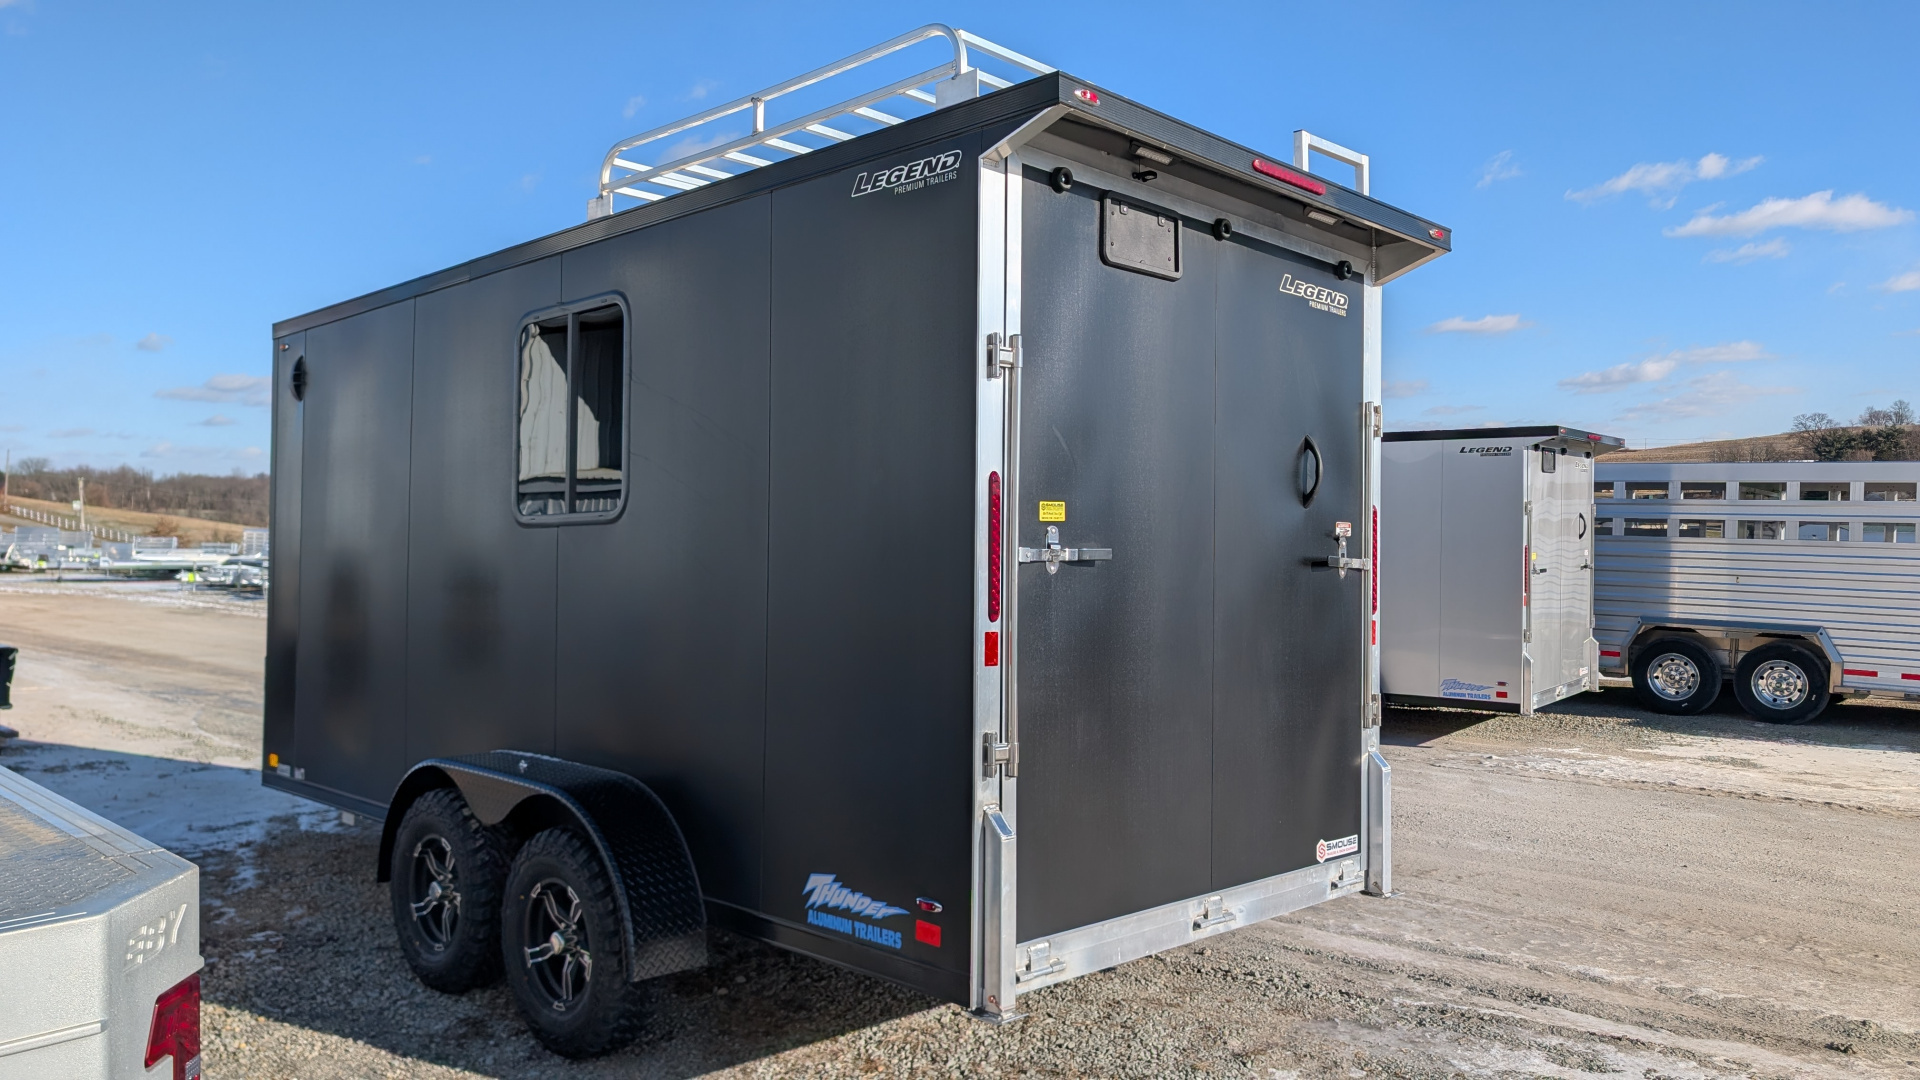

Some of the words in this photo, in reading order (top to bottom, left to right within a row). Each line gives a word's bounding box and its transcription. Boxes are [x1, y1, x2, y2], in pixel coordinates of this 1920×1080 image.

[851, 150, 962, 197] LEGEND
[894, 180, 925, 195] PREMIUM
[926, 170, 957, 186] TRAILERS
[1280, 274, 1349, 309] LEGEND
[1309, 300, 1329, 312] PREMIUM
[1326, 836, 1357, 851] SMOUSE
[802, 873, 911, 920] THUNDER
[807, 909, 852, 934] ALUMINUM
[854, 920, 902, 949] TRAILERS
